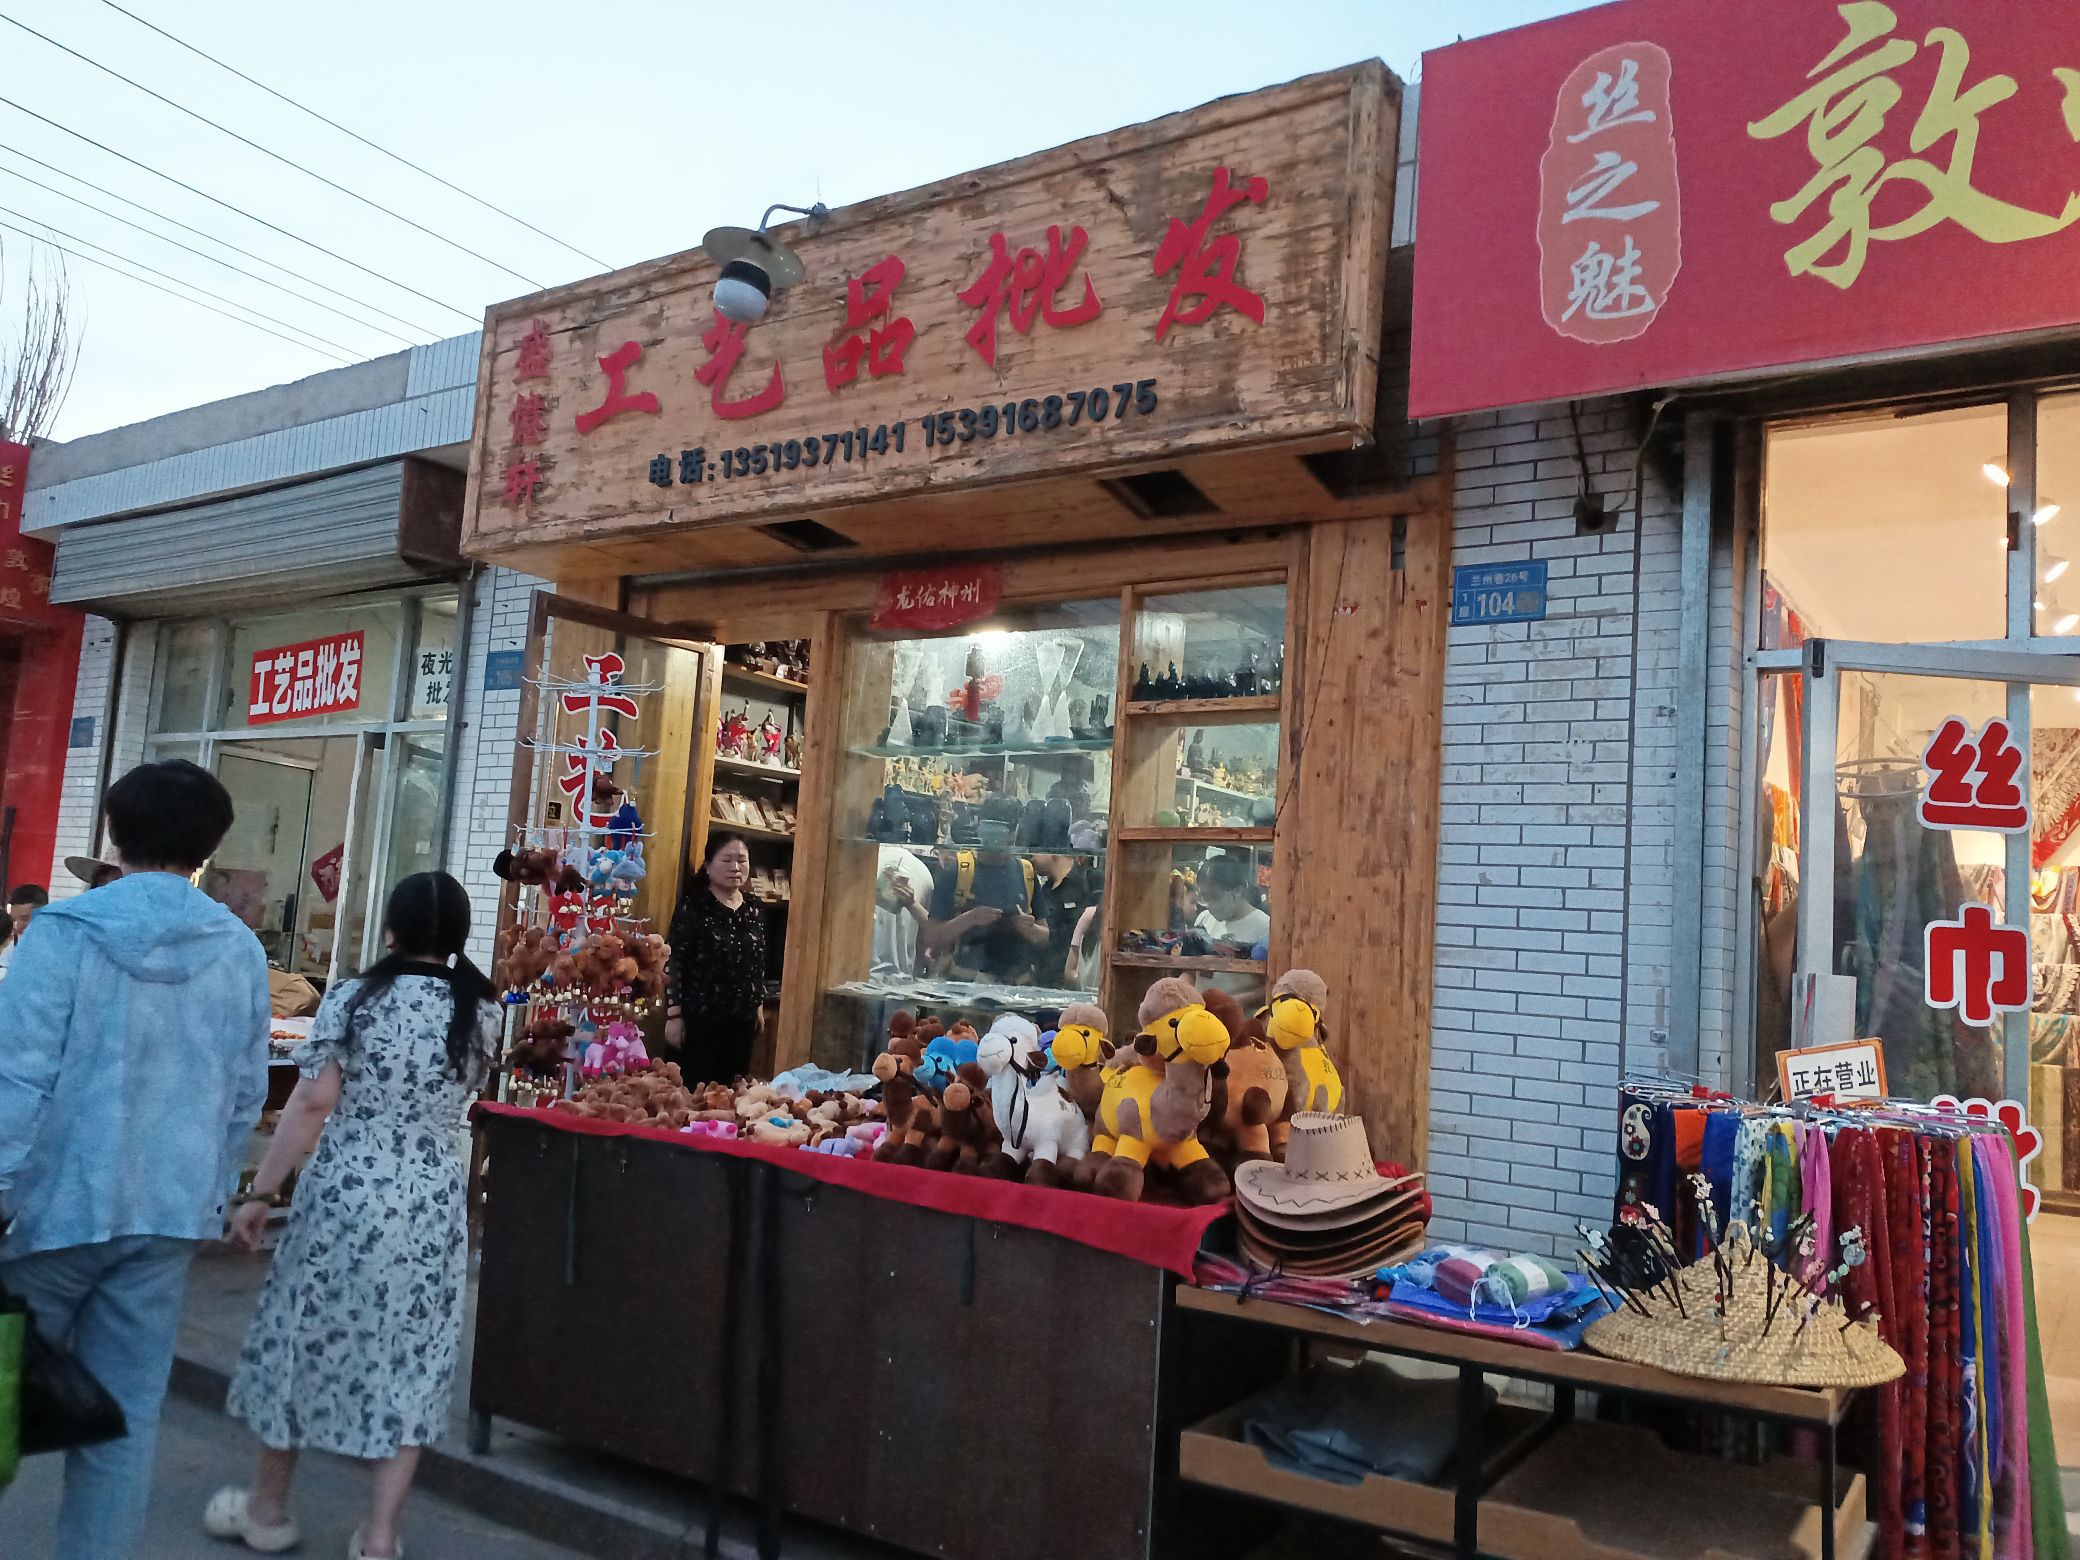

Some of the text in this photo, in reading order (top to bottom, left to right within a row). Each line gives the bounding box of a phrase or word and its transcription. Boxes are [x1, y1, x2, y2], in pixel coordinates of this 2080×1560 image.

[1747, 1, 2080, 289] 敦
[1562, 59, 1660, 323] 丝之魅
[574, 166, 1269, 435] 工艺品批发
[922, 378, 1157, 447] 15391687075
[1476, 591, 1515, 618] 104
[250, 638, 361, 716] 工艺品批发
[1792, 1060, 1876, 1097] 正在营业
